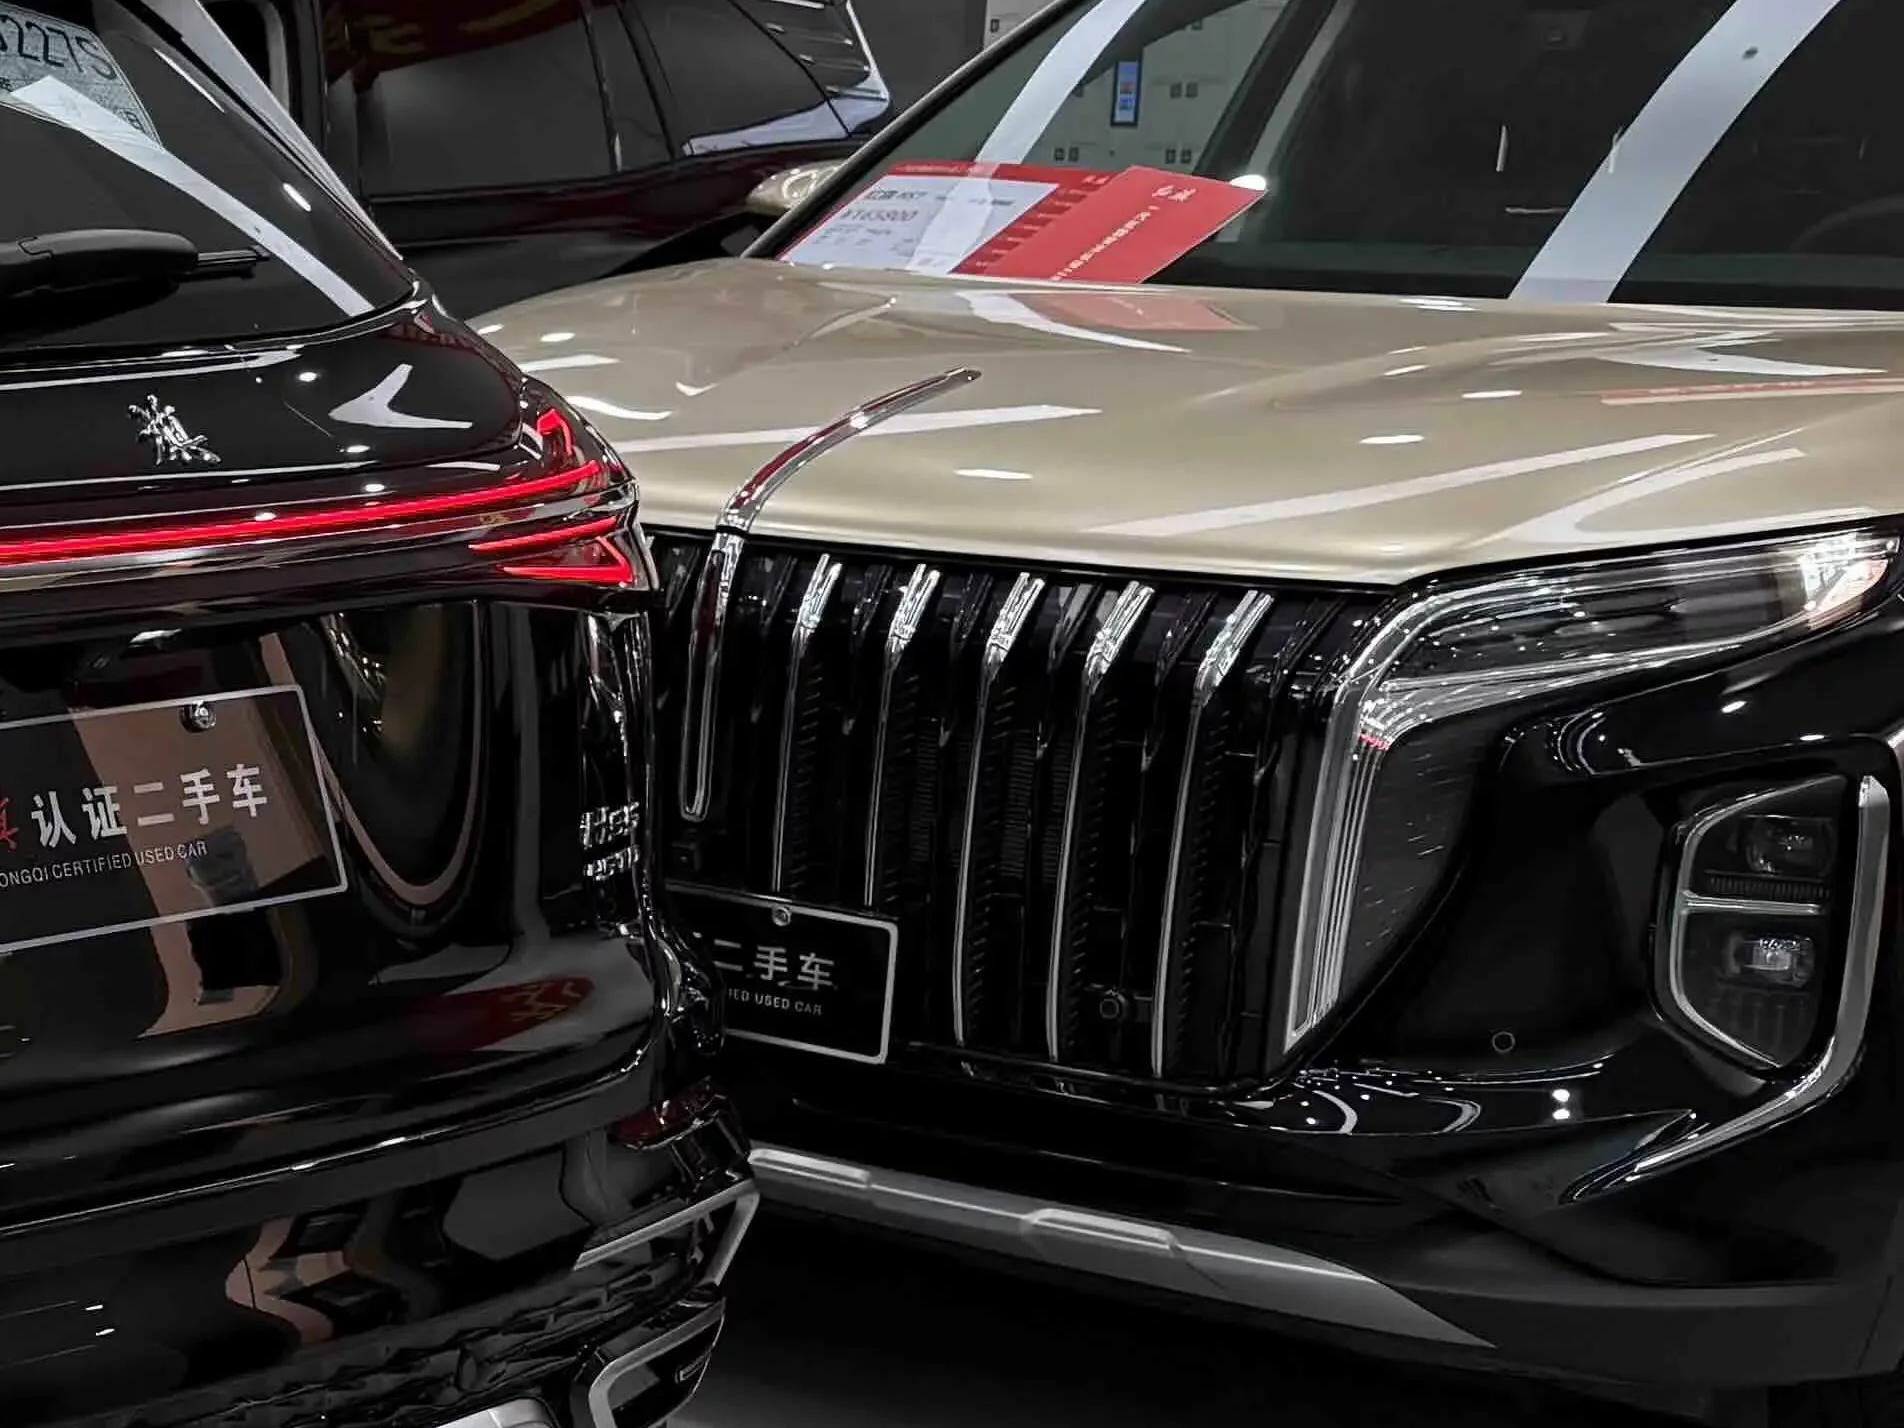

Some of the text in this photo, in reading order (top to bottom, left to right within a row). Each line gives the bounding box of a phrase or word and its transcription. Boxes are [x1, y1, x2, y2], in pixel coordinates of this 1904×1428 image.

[52, 852, 132, 877] CERTIFIED
[135, 846, 174, 866] USED
[177, 840, 208, 860] CAR
[693, 931, 836, 991] 二手车
[754, 991, 791, 1010] USED
[794, 1000, 823, 1017] CAR
